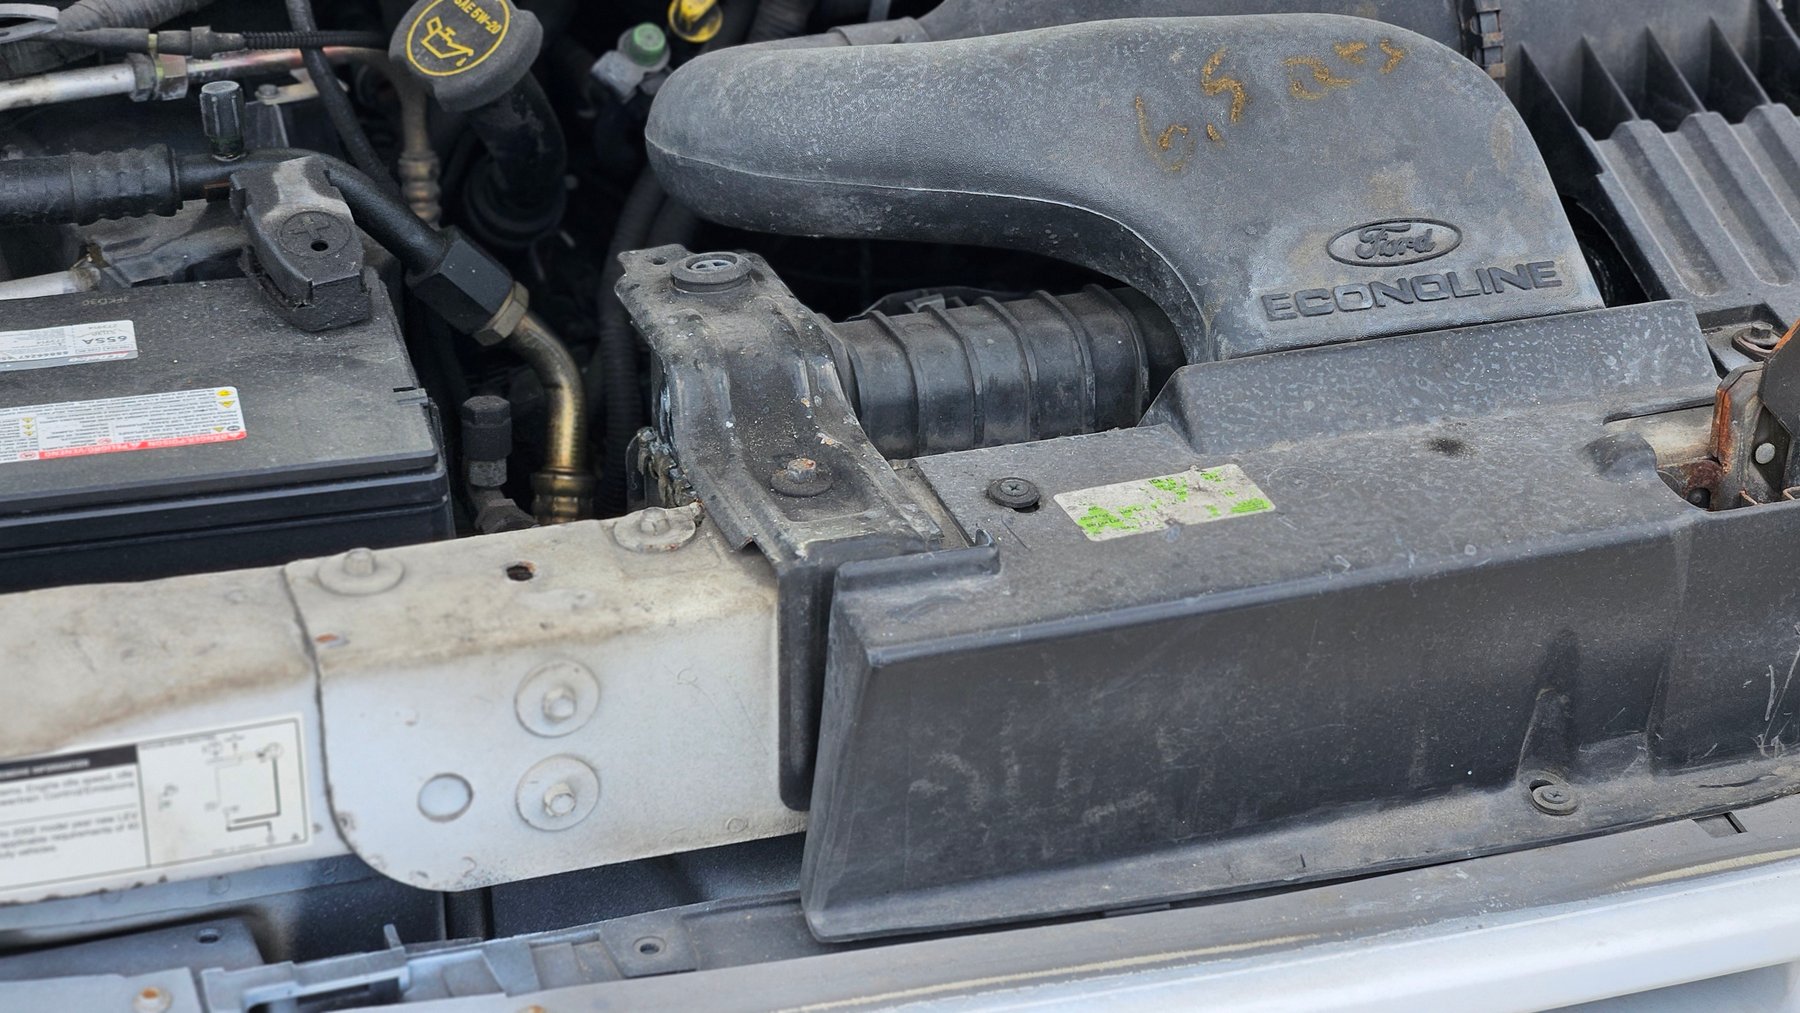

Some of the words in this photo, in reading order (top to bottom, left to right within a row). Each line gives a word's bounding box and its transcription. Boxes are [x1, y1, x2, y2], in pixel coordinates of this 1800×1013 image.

[470, 7, 502, 34] 5W-20
[1355, 223, 1436, 259] Ford
[1261, 260, 1562, 321] ECONOLINE
